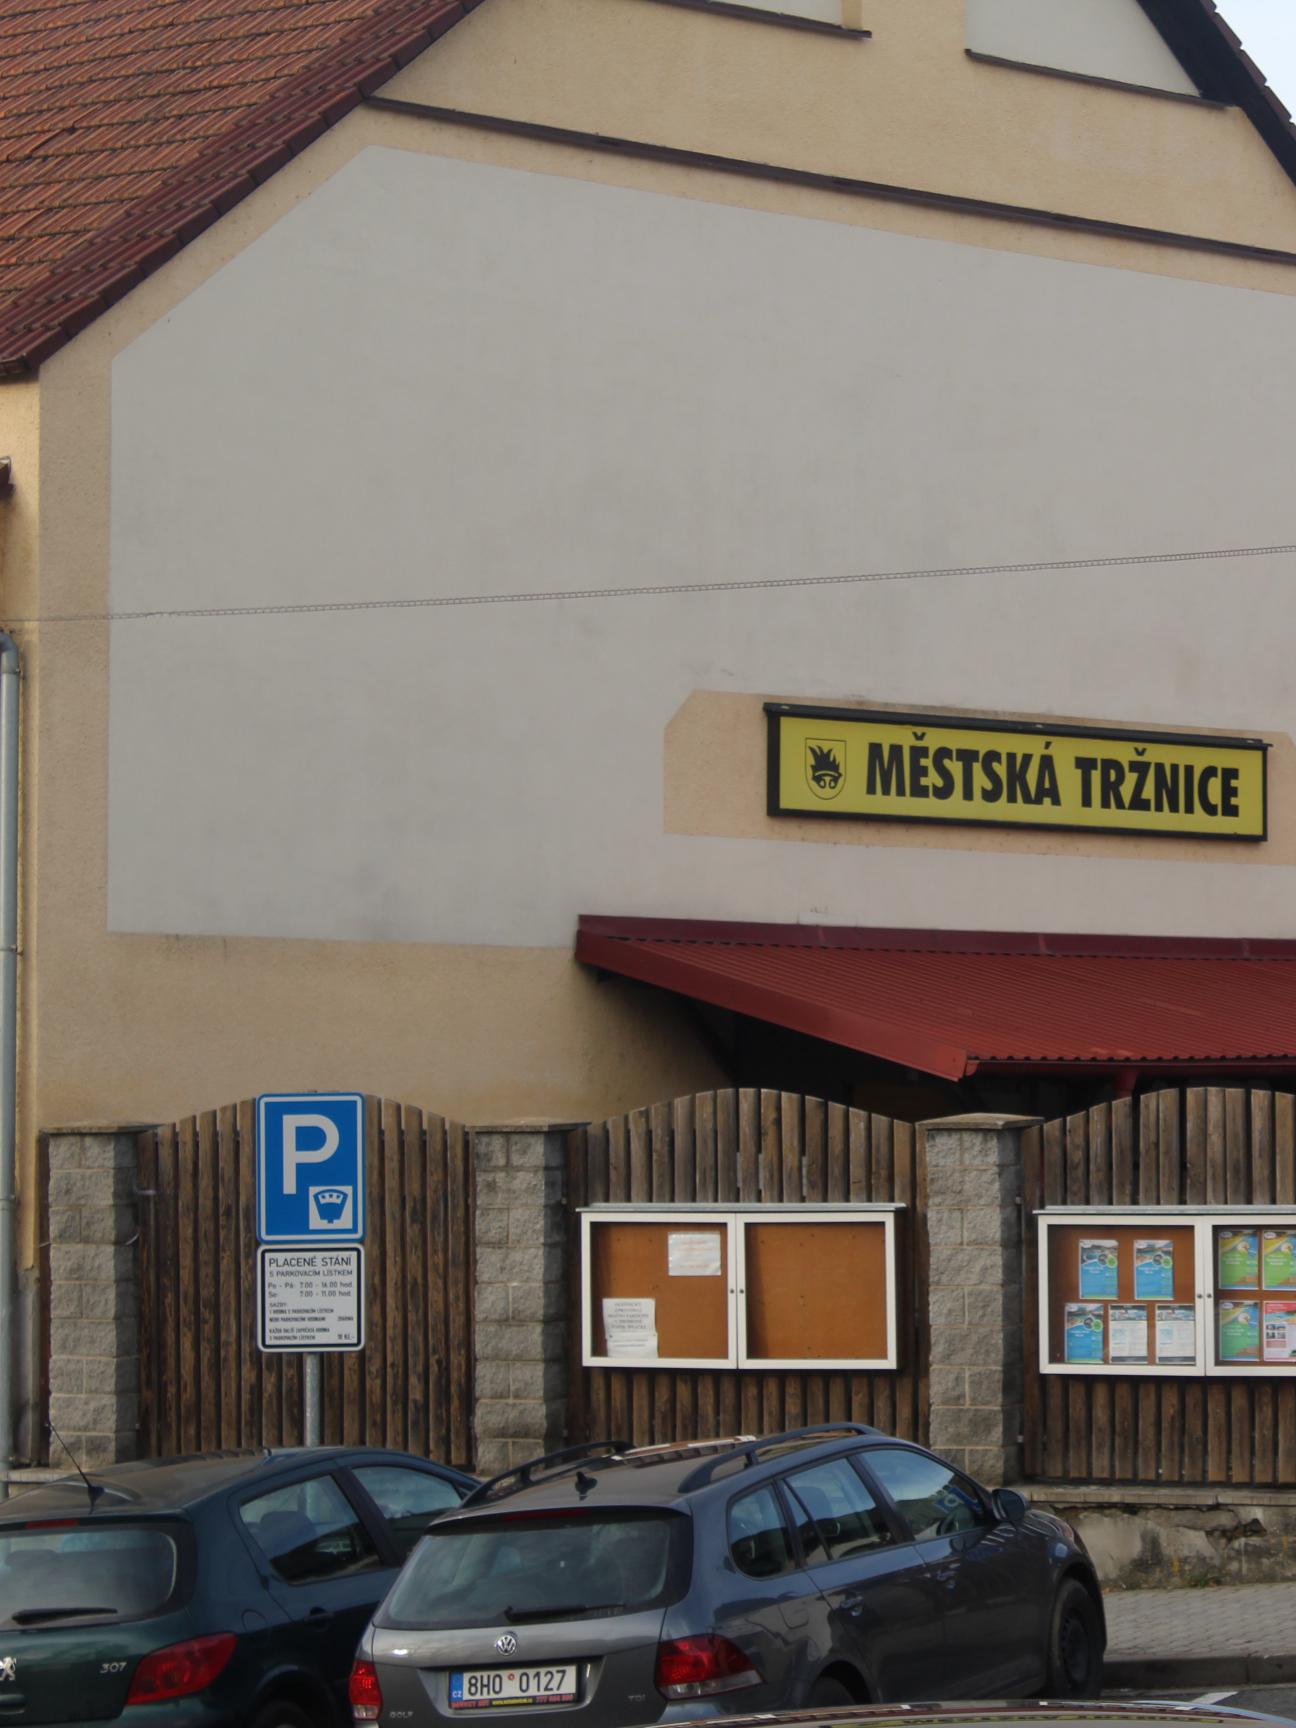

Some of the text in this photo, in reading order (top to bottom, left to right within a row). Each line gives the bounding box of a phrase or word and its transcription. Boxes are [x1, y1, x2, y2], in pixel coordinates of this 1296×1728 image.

[866, 731, 1240, 819] MĚSTSKÁ TRŽNICE
[282, 1113, 340, 1195] P
[269, 1254, 352, 1268] PLACENÉ STÁNÍ
[100, 1661, 127, 1674] 307
[468, 1669, 567, 1697] 8H0 0127
[452, 1690, 462, 1698] CZ
[389, 1711, 414, 1719] GOLF
